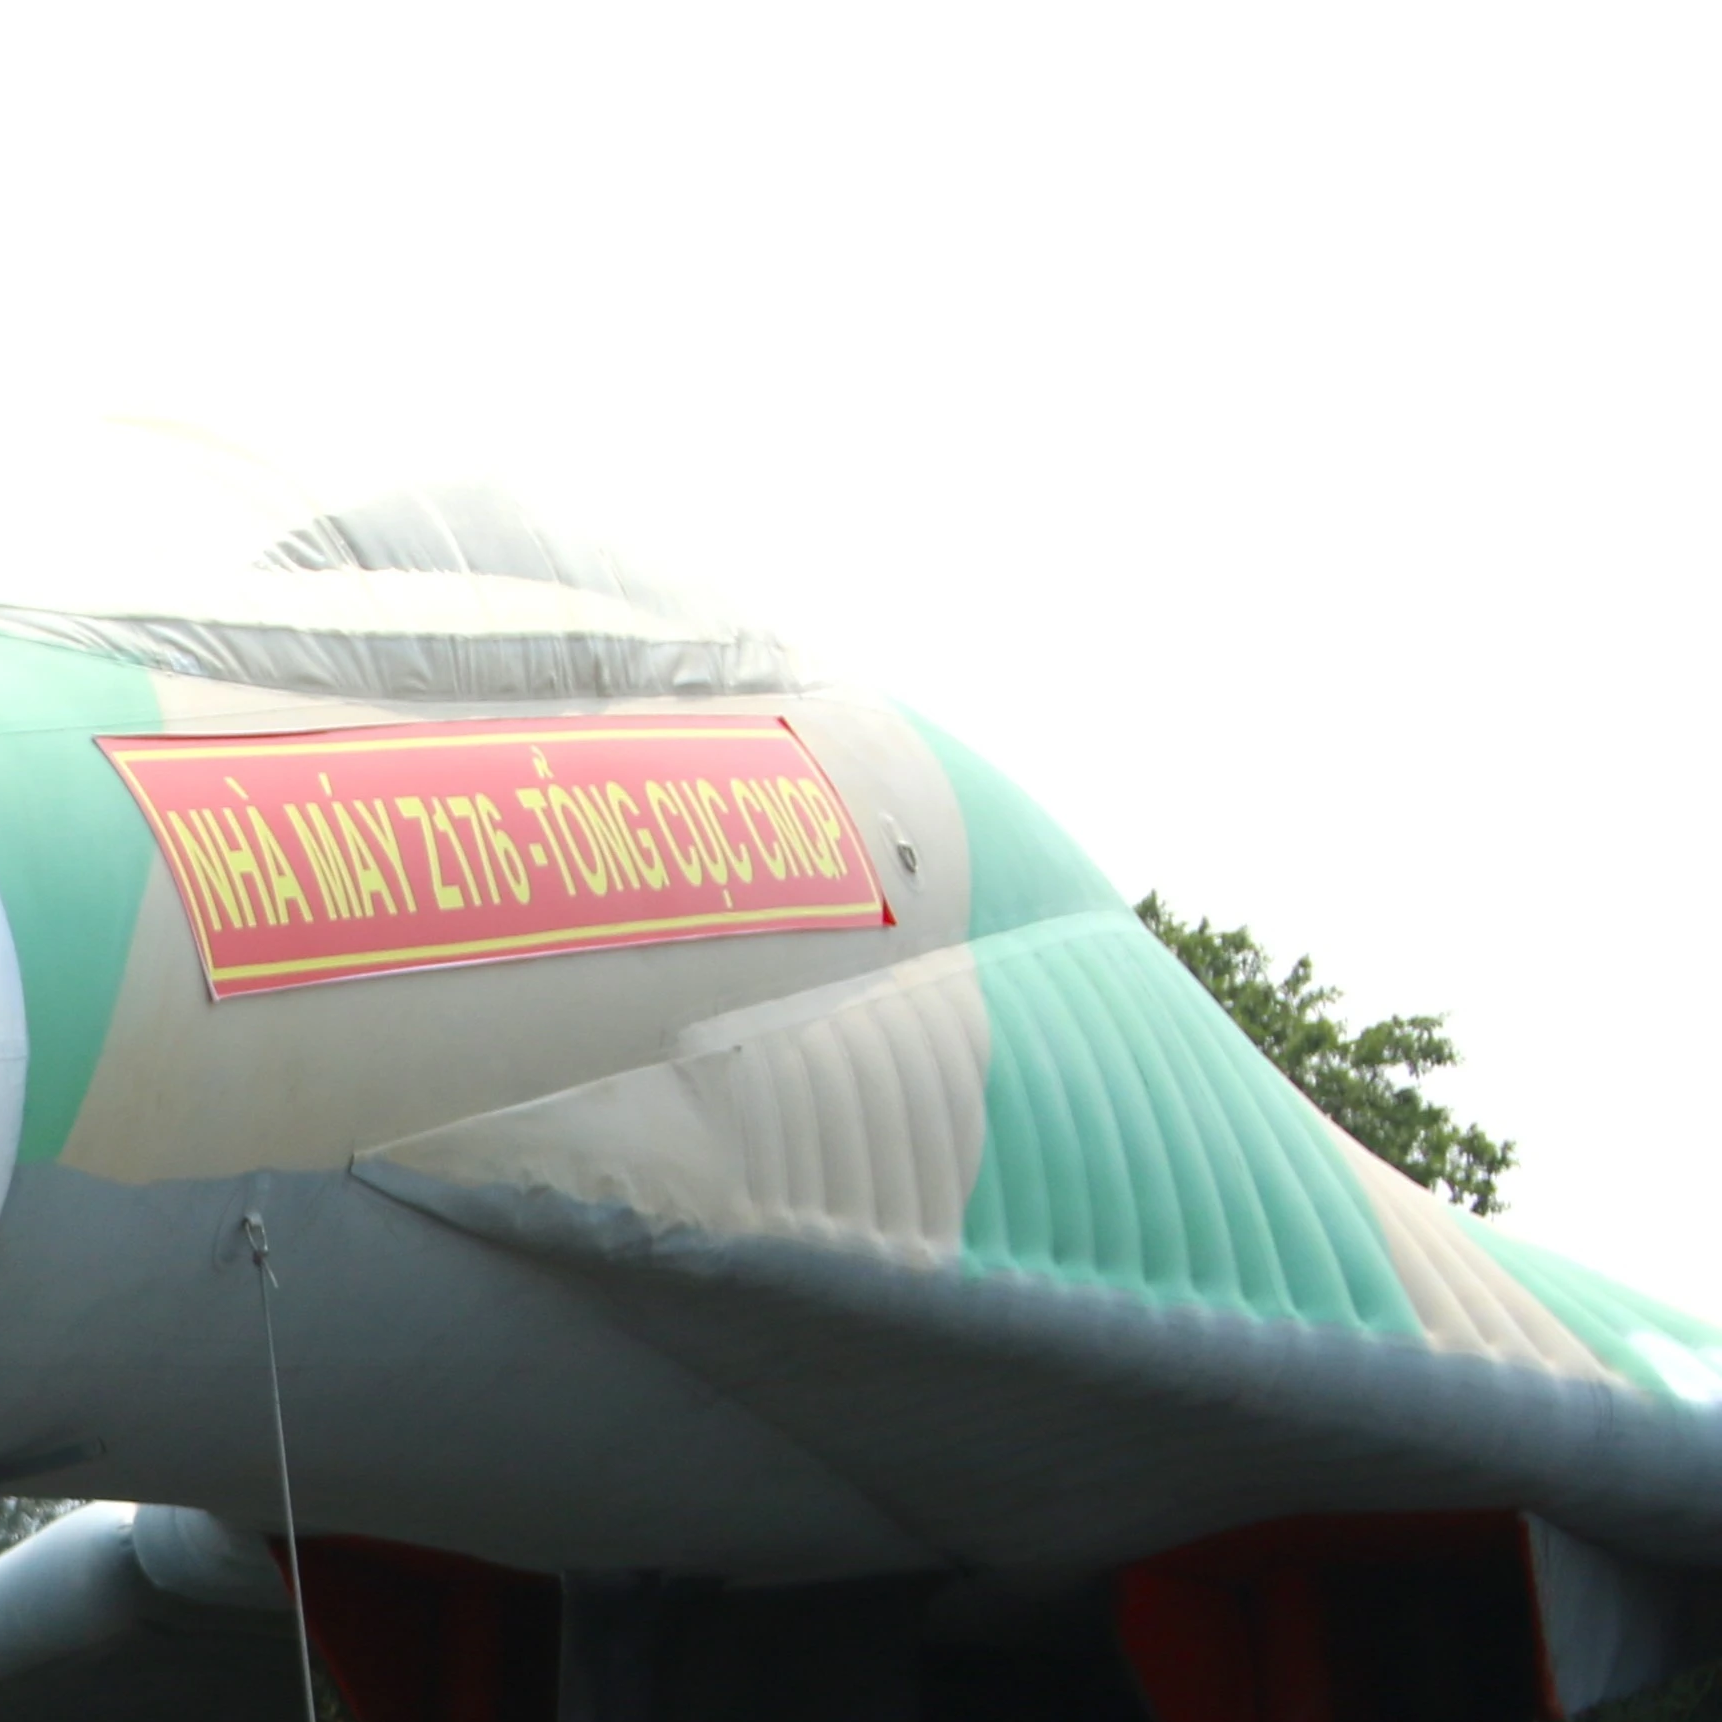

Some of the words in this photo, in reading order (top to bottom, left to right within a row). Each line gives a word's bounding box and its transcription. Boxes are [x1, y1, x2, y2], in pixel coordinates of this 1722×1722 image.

[166, 776, 314, 931] NHÀ
[283, 772, 418, 921] MÁY
[394, 793, 531, 910] Z176
[645, 779, 753, 909] CỤC
[730, 777, 848, 881] CNQP
